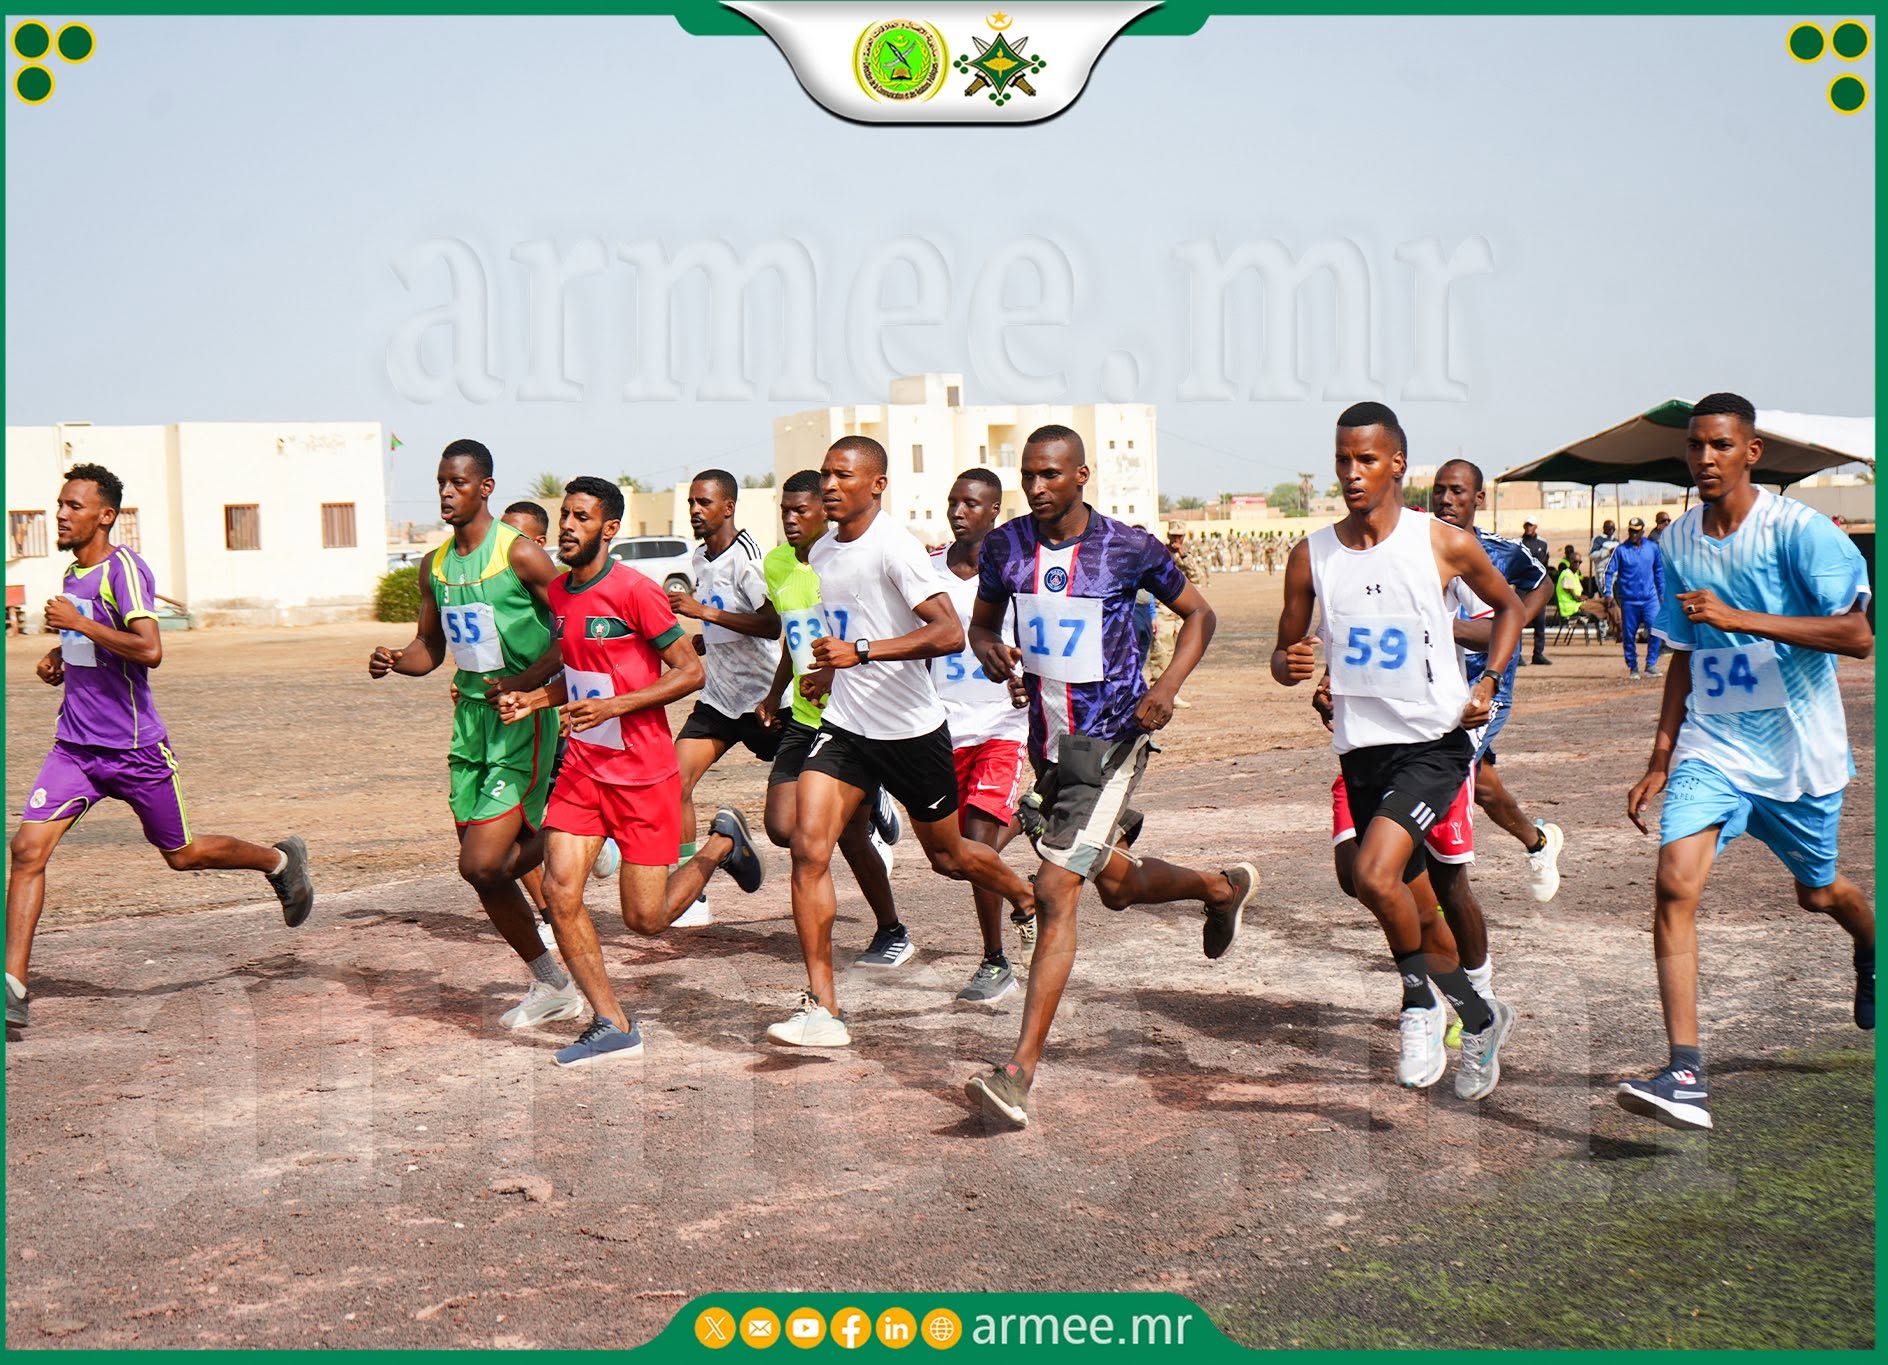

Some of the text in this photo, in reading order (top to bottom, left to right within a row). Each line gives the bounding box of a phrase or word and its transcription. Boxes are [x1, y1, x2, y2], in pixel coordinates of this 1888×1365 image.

[446, 611, 480, 644] 55
[786, 618, 823, 651] 63
[1029, 616, 1085, 657] 17
[1344, 627, 1408, 670] 59
[1703, 653, 1758, 697] 54
[490, 780, 505, 797] 2
